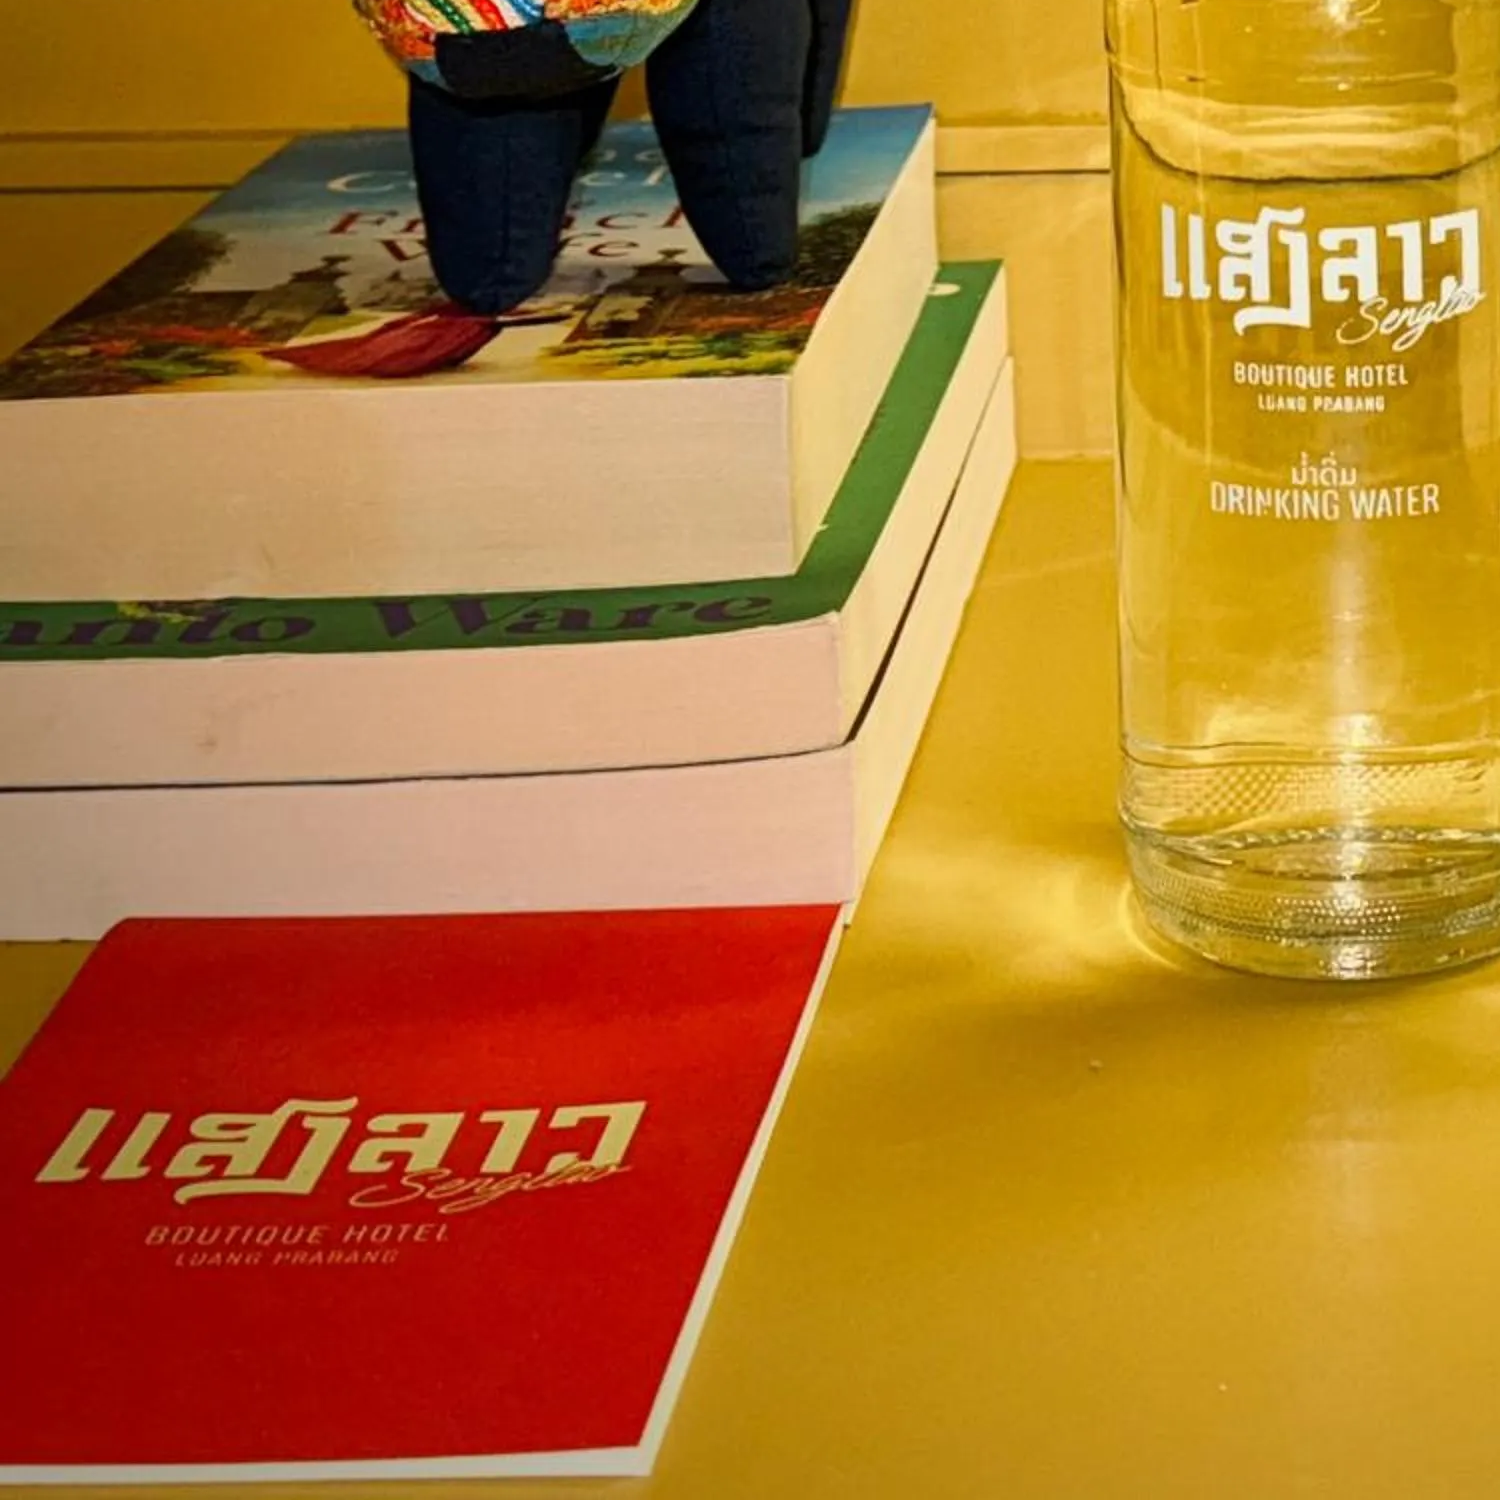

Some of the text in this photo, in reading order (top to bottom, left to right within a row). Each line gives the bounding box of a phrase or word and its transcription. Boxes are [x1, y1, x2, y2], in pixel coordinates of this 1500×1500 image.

[1233, 360, 1409, 389] BOUTIQUE HOTEL
[1258, 393, 1386, 413] LUANG PRABANG
[1210, 480, 1441, 521] DRINKING WATER
[144, 1222, 450, 1248] BOUTIQUE HOTEL
[174, 1250, 263, 1268] LUANG
